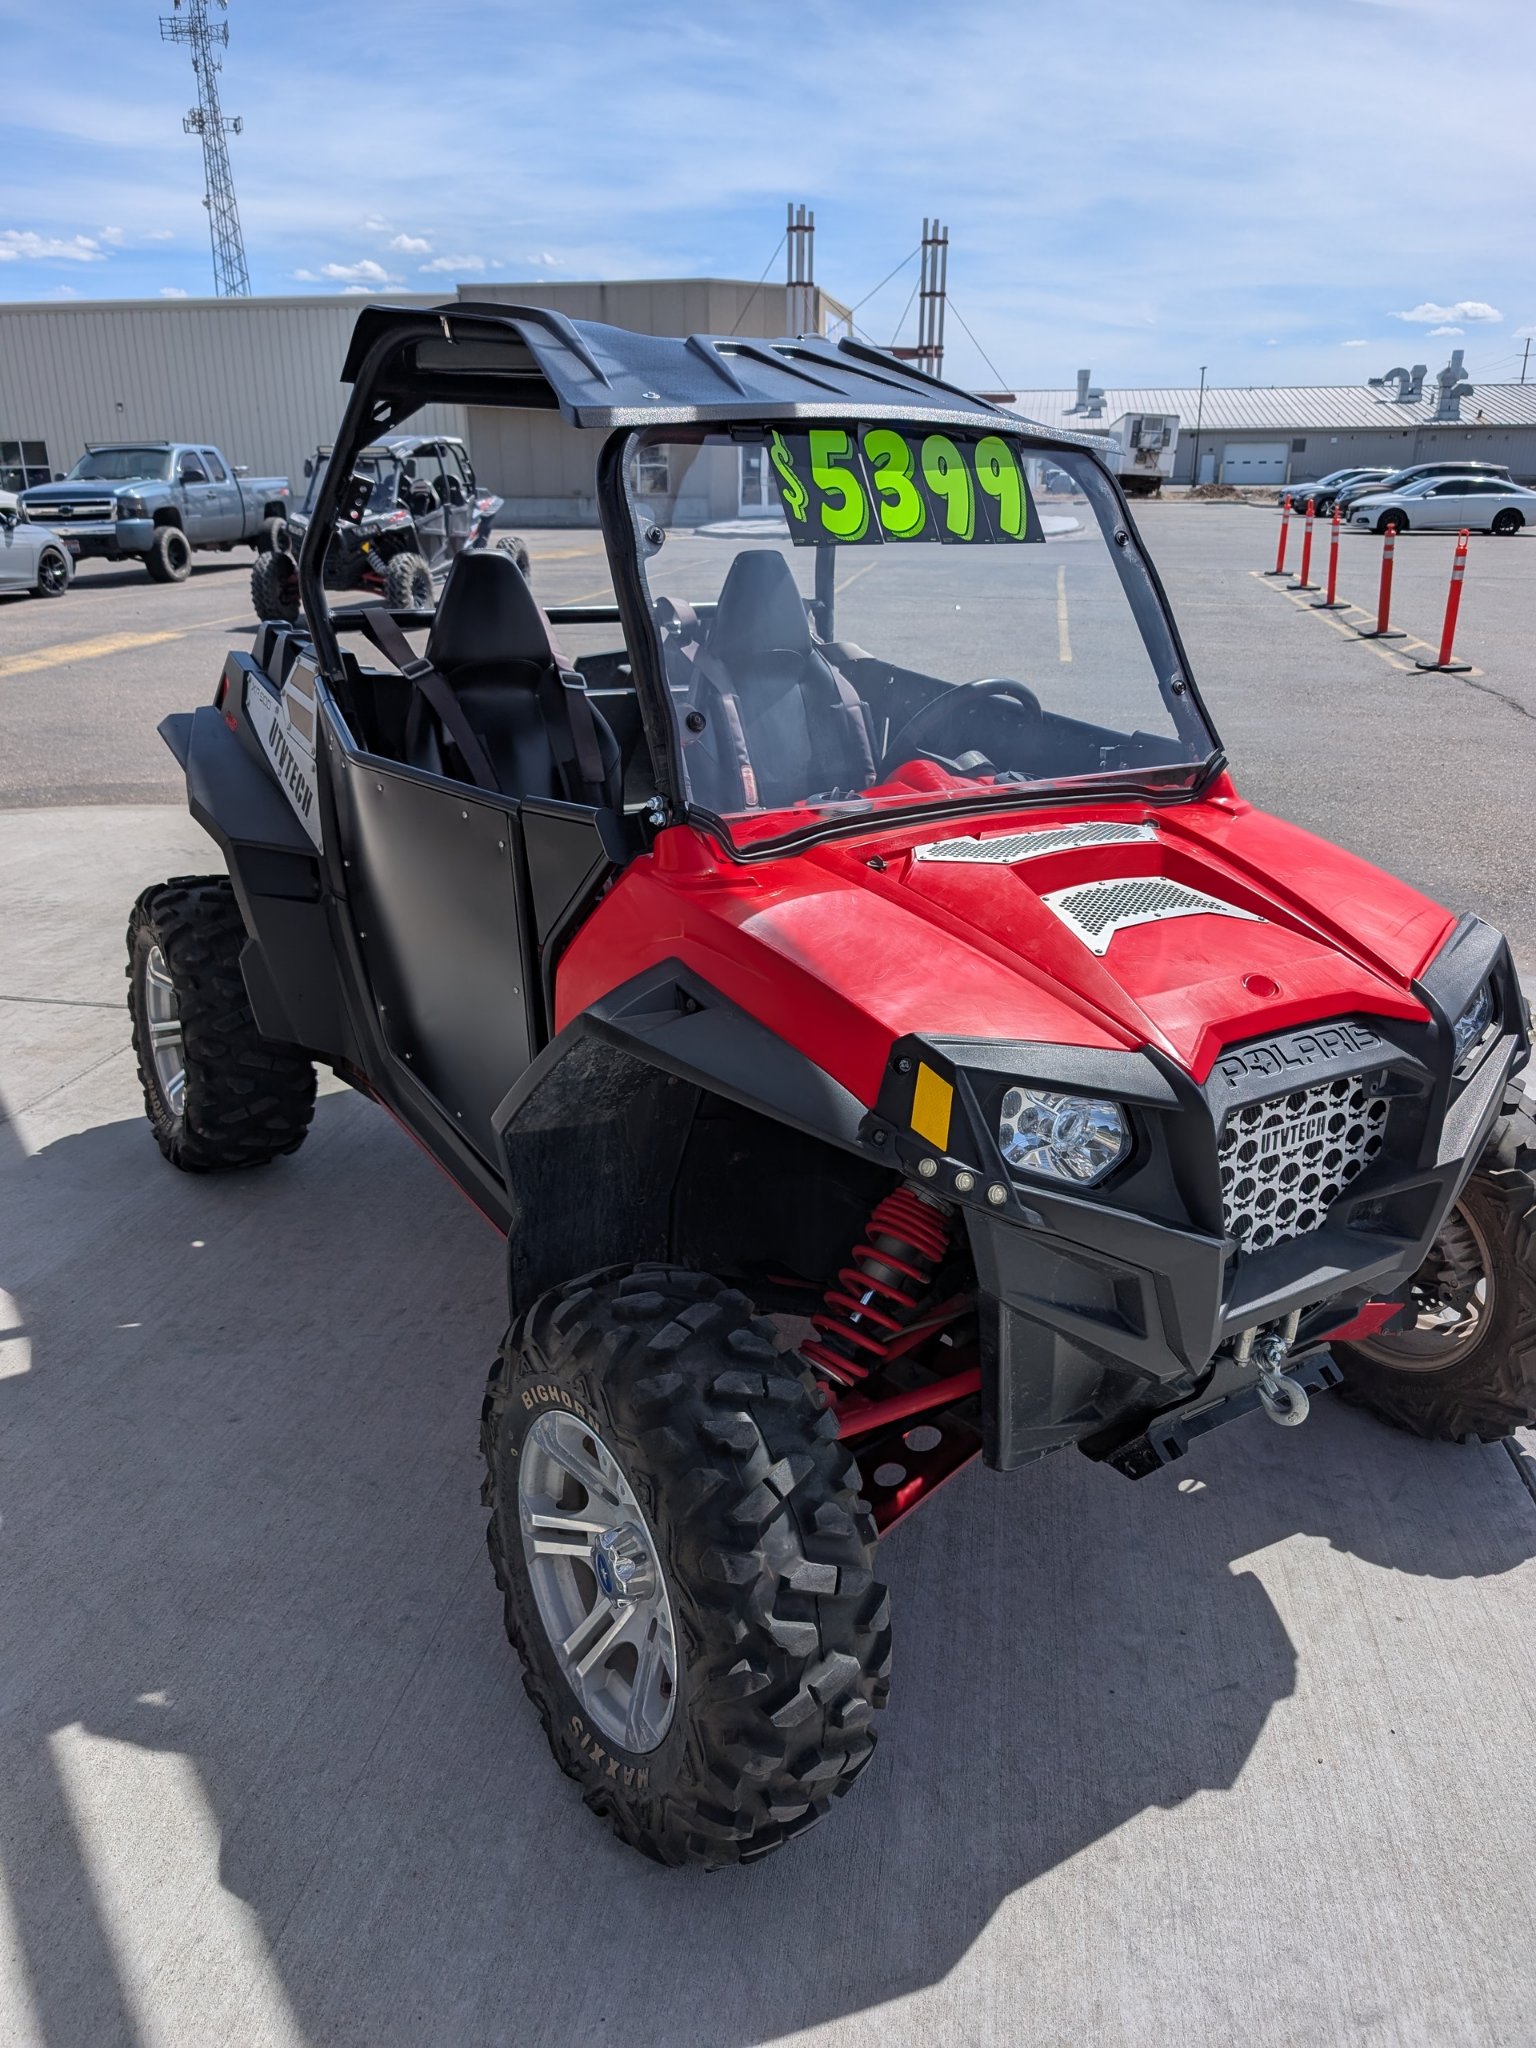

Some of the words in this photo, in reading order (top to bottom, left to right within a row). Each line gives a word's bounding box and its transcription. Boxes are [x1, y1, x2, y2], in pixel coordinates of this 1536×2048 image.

[770, 428, 1028, 542] $5399
[268, 716, 314, 818] UTVTECH
[1216, 1022, 1383, 1090] POLARIS
[1260, 1115, 1327, 1154] UTVTECH
[521, 1384, 600, 1434] BIGHORN
[568, 1715, 649, 1789] MAXXIS
